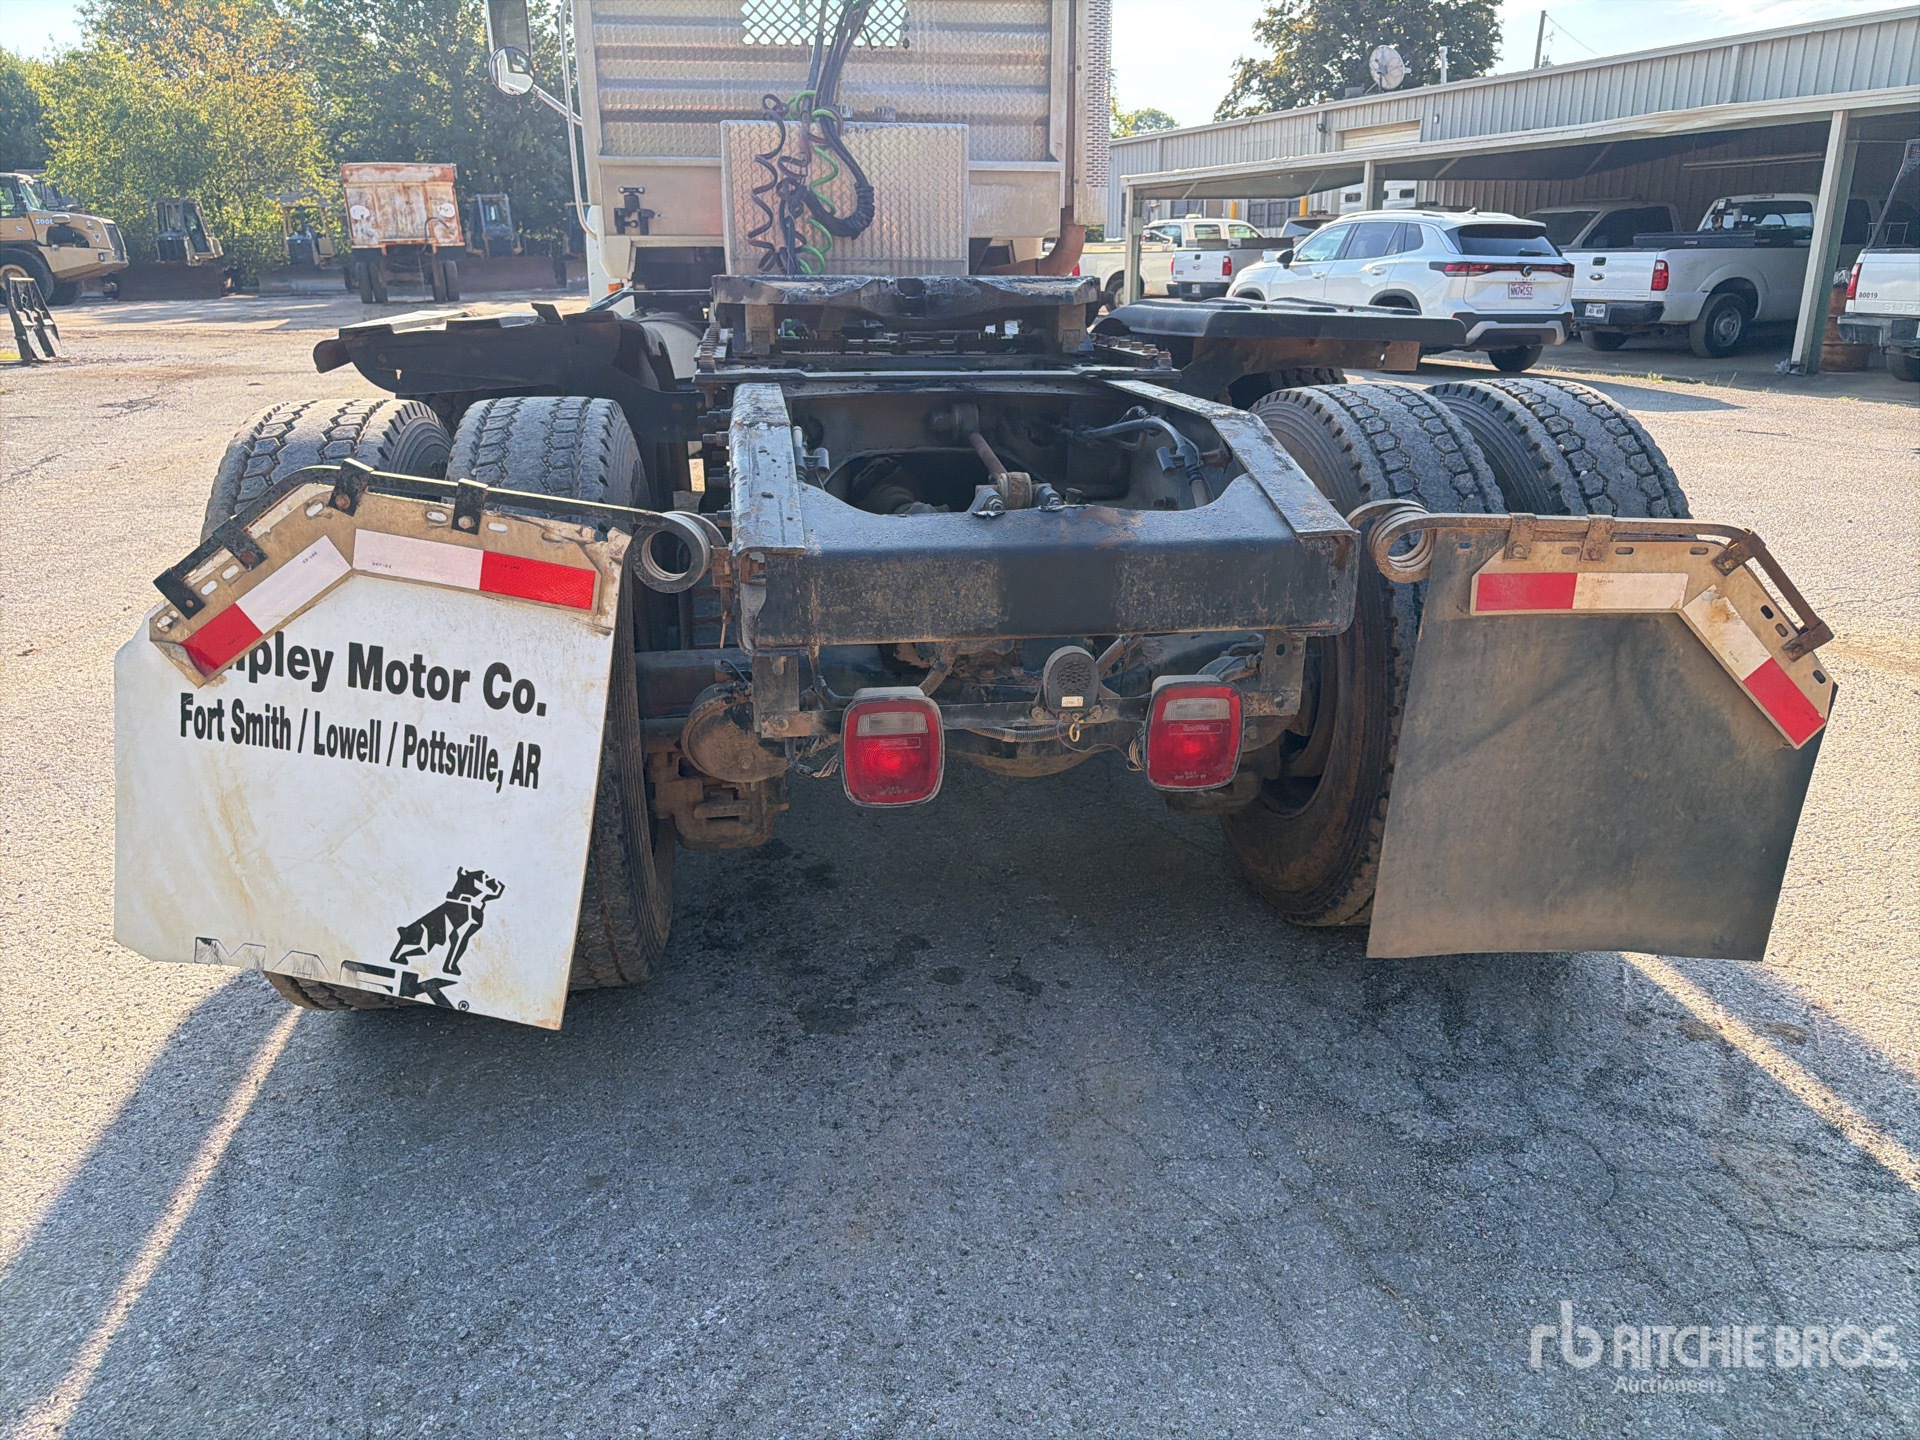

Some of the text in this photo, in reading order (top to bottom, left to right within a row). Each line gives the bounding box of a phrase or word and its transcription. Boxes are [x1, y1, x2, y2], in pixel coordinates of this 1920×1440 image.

[1859, 291, 1878, 299] 80019
[227, 630, 547, 717] pley Motor Co.
[180, 692, 225, 742] Fort
[230, 698, 292, 751] Smith
[313, 710, 382, 764] Lowell
[402, 724, 504, 794] Pottsville,
[509, 741, 541, 790] AR
